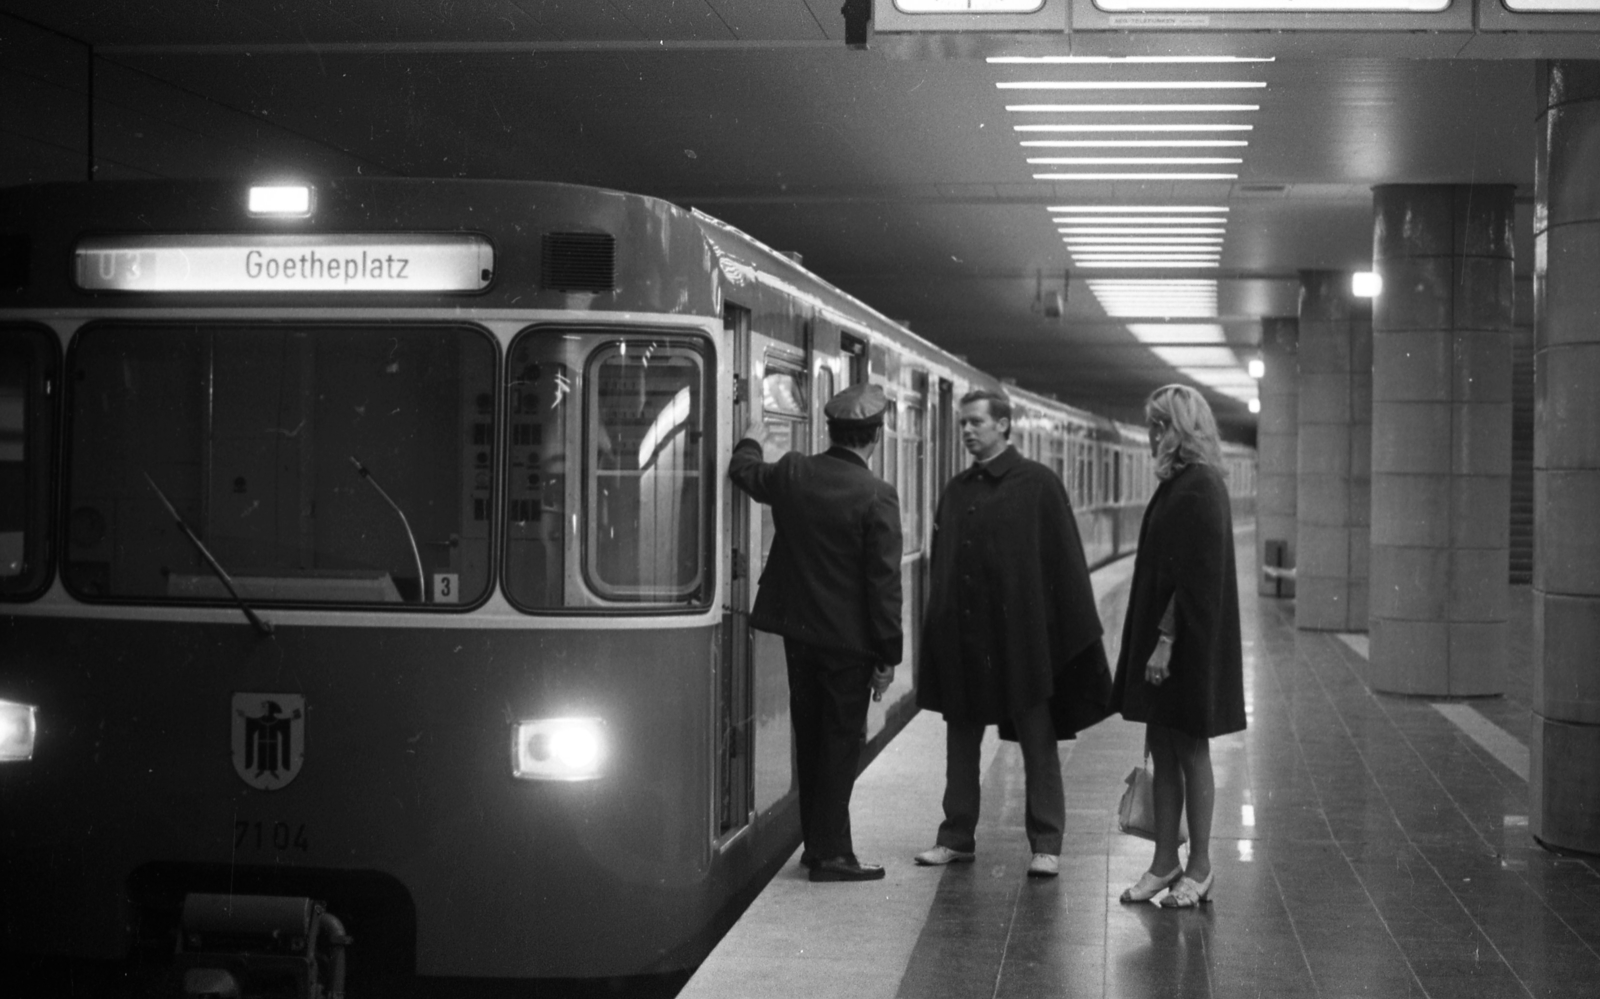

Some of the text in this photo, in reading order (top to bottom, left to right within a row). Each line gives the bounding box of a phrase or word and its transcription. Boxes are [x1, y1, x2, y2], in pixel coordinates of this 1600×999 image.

[101, 249, 410, 285] U 3 Goetheplatz
[440, 576, 451, 597] 3
[234, 821, 308, 851] 7104
